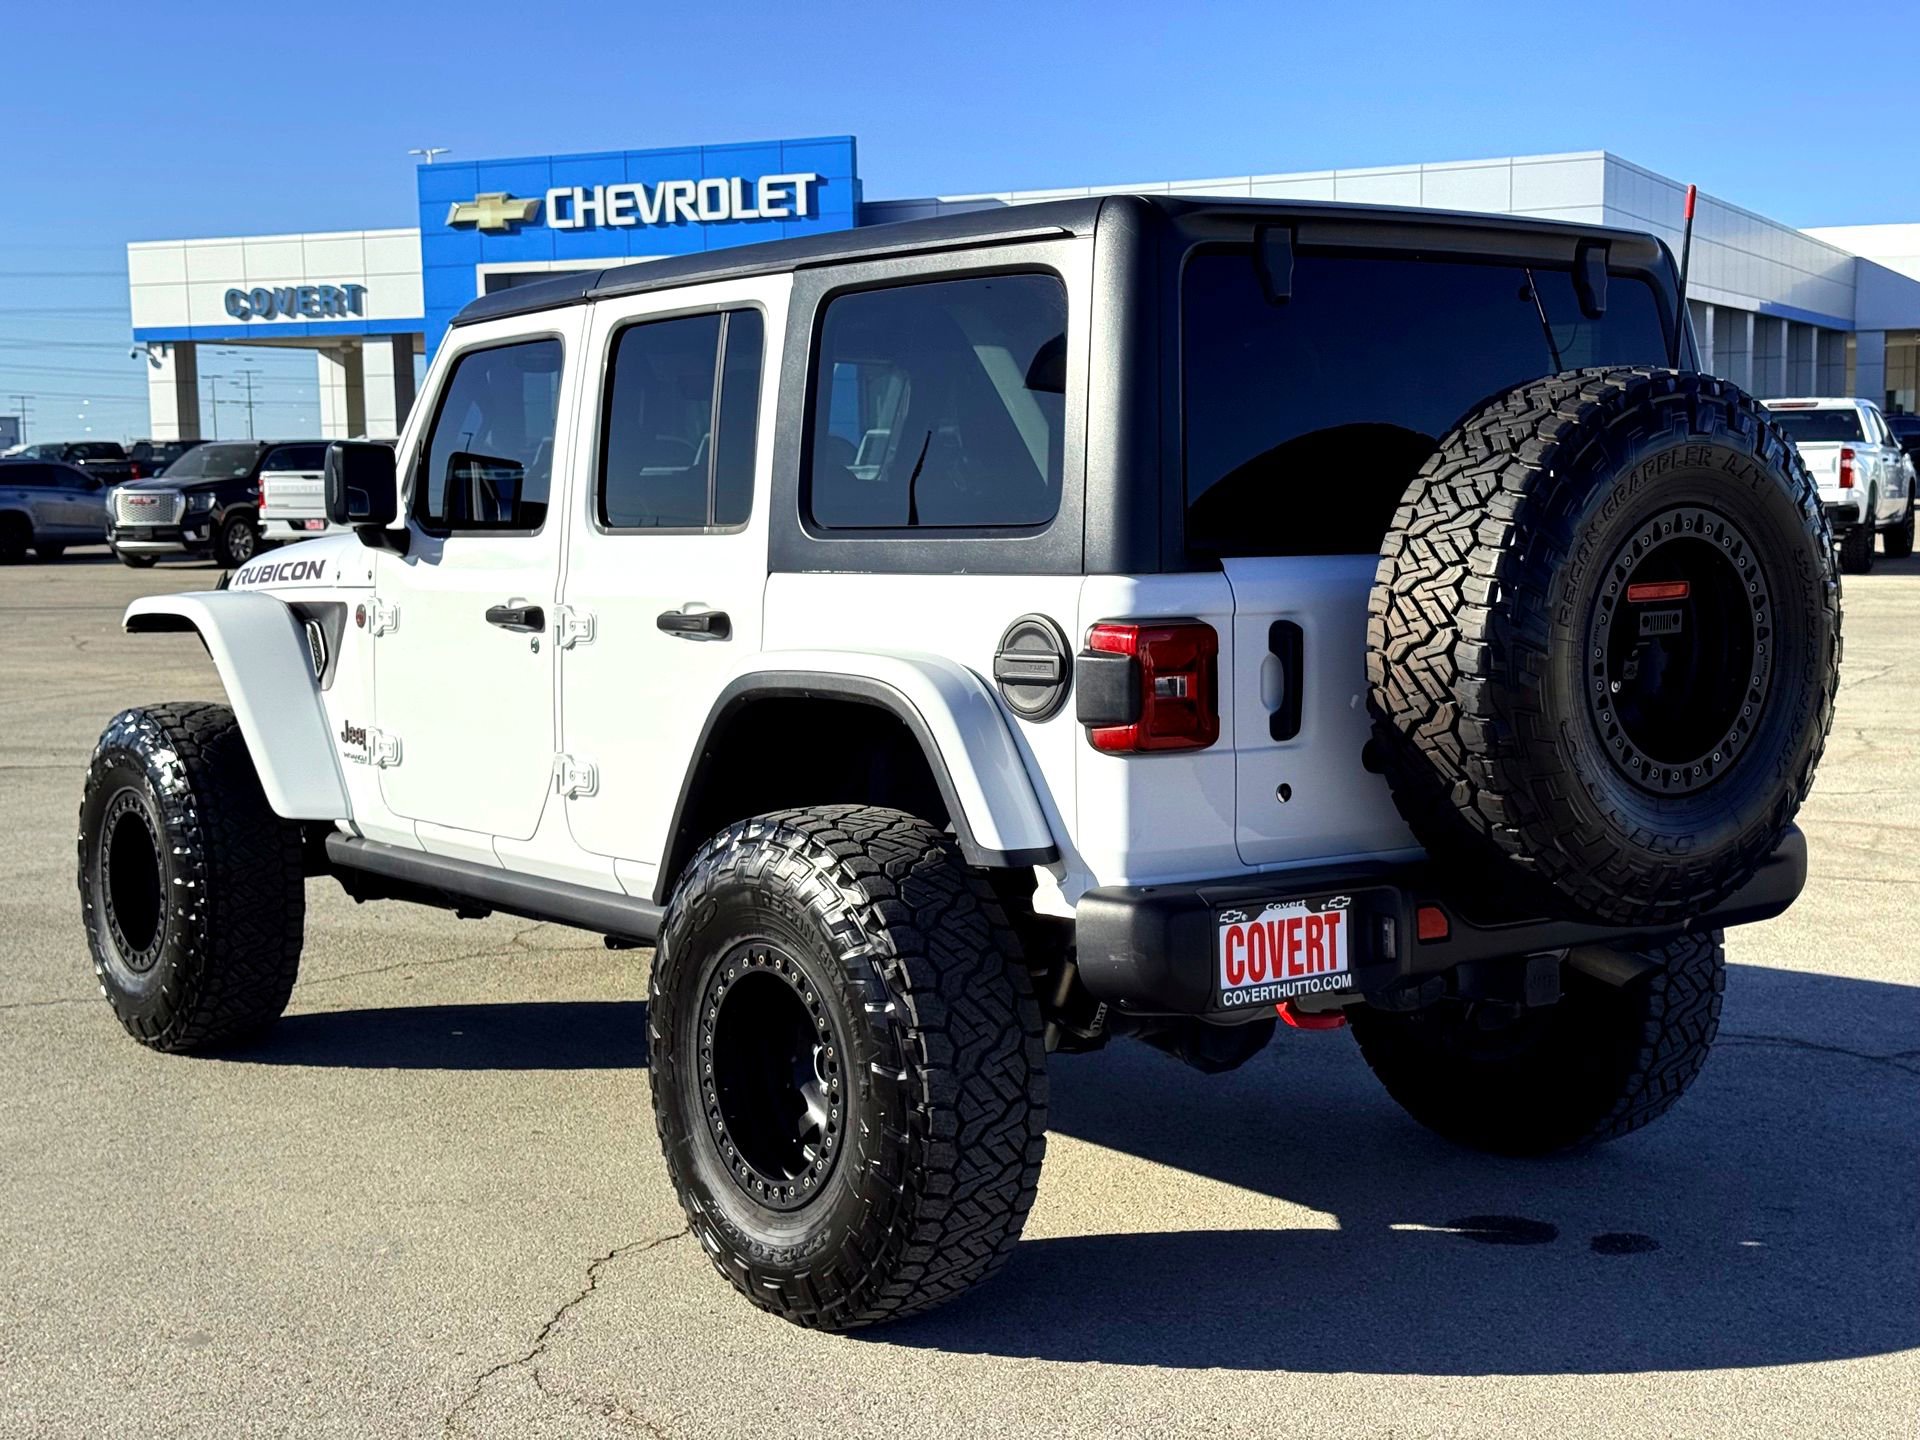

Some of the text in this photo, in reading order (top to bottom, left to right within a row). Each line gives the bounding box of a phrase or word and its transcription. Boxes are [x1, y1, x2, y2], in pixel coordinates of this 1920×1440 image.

[545, 172, 816, 229] CHEVROLET
[225, 284, 366, 321] COVERT
[234, 559, 326, 586] RUBICON
[341, 719, 367, 751] Jeep
[1265, 899, 1307, 911] Covert
[1225, 911, 1341, 987] COVERT
[1222, 973, 1353, 1007] COVERTHUTTO.COM
